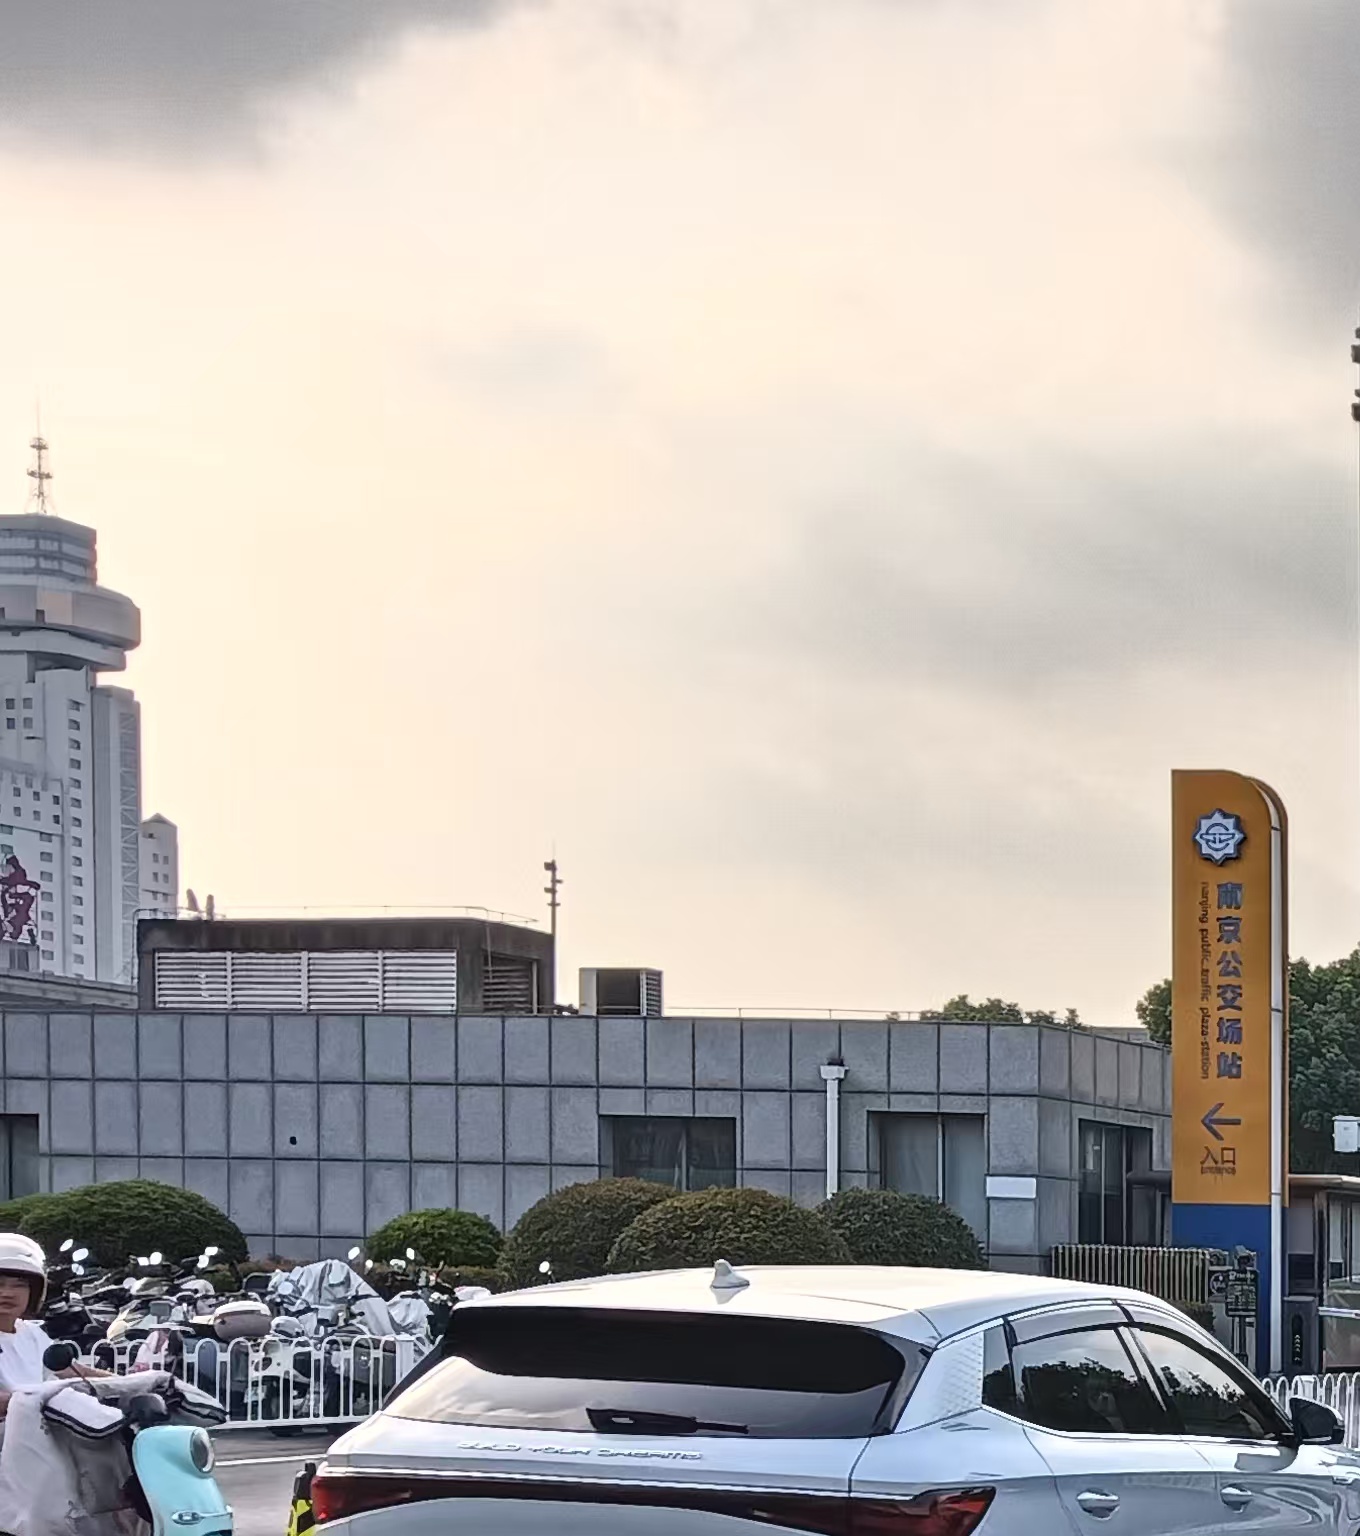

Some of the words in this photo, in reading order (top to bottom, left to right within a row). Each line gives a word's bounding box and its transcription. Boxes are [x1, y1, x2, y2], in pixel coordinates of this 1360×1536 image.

[1216, 881, 1243, 1079] 南京公交场站
[1200, 1146, 1236, 1166] 入口
